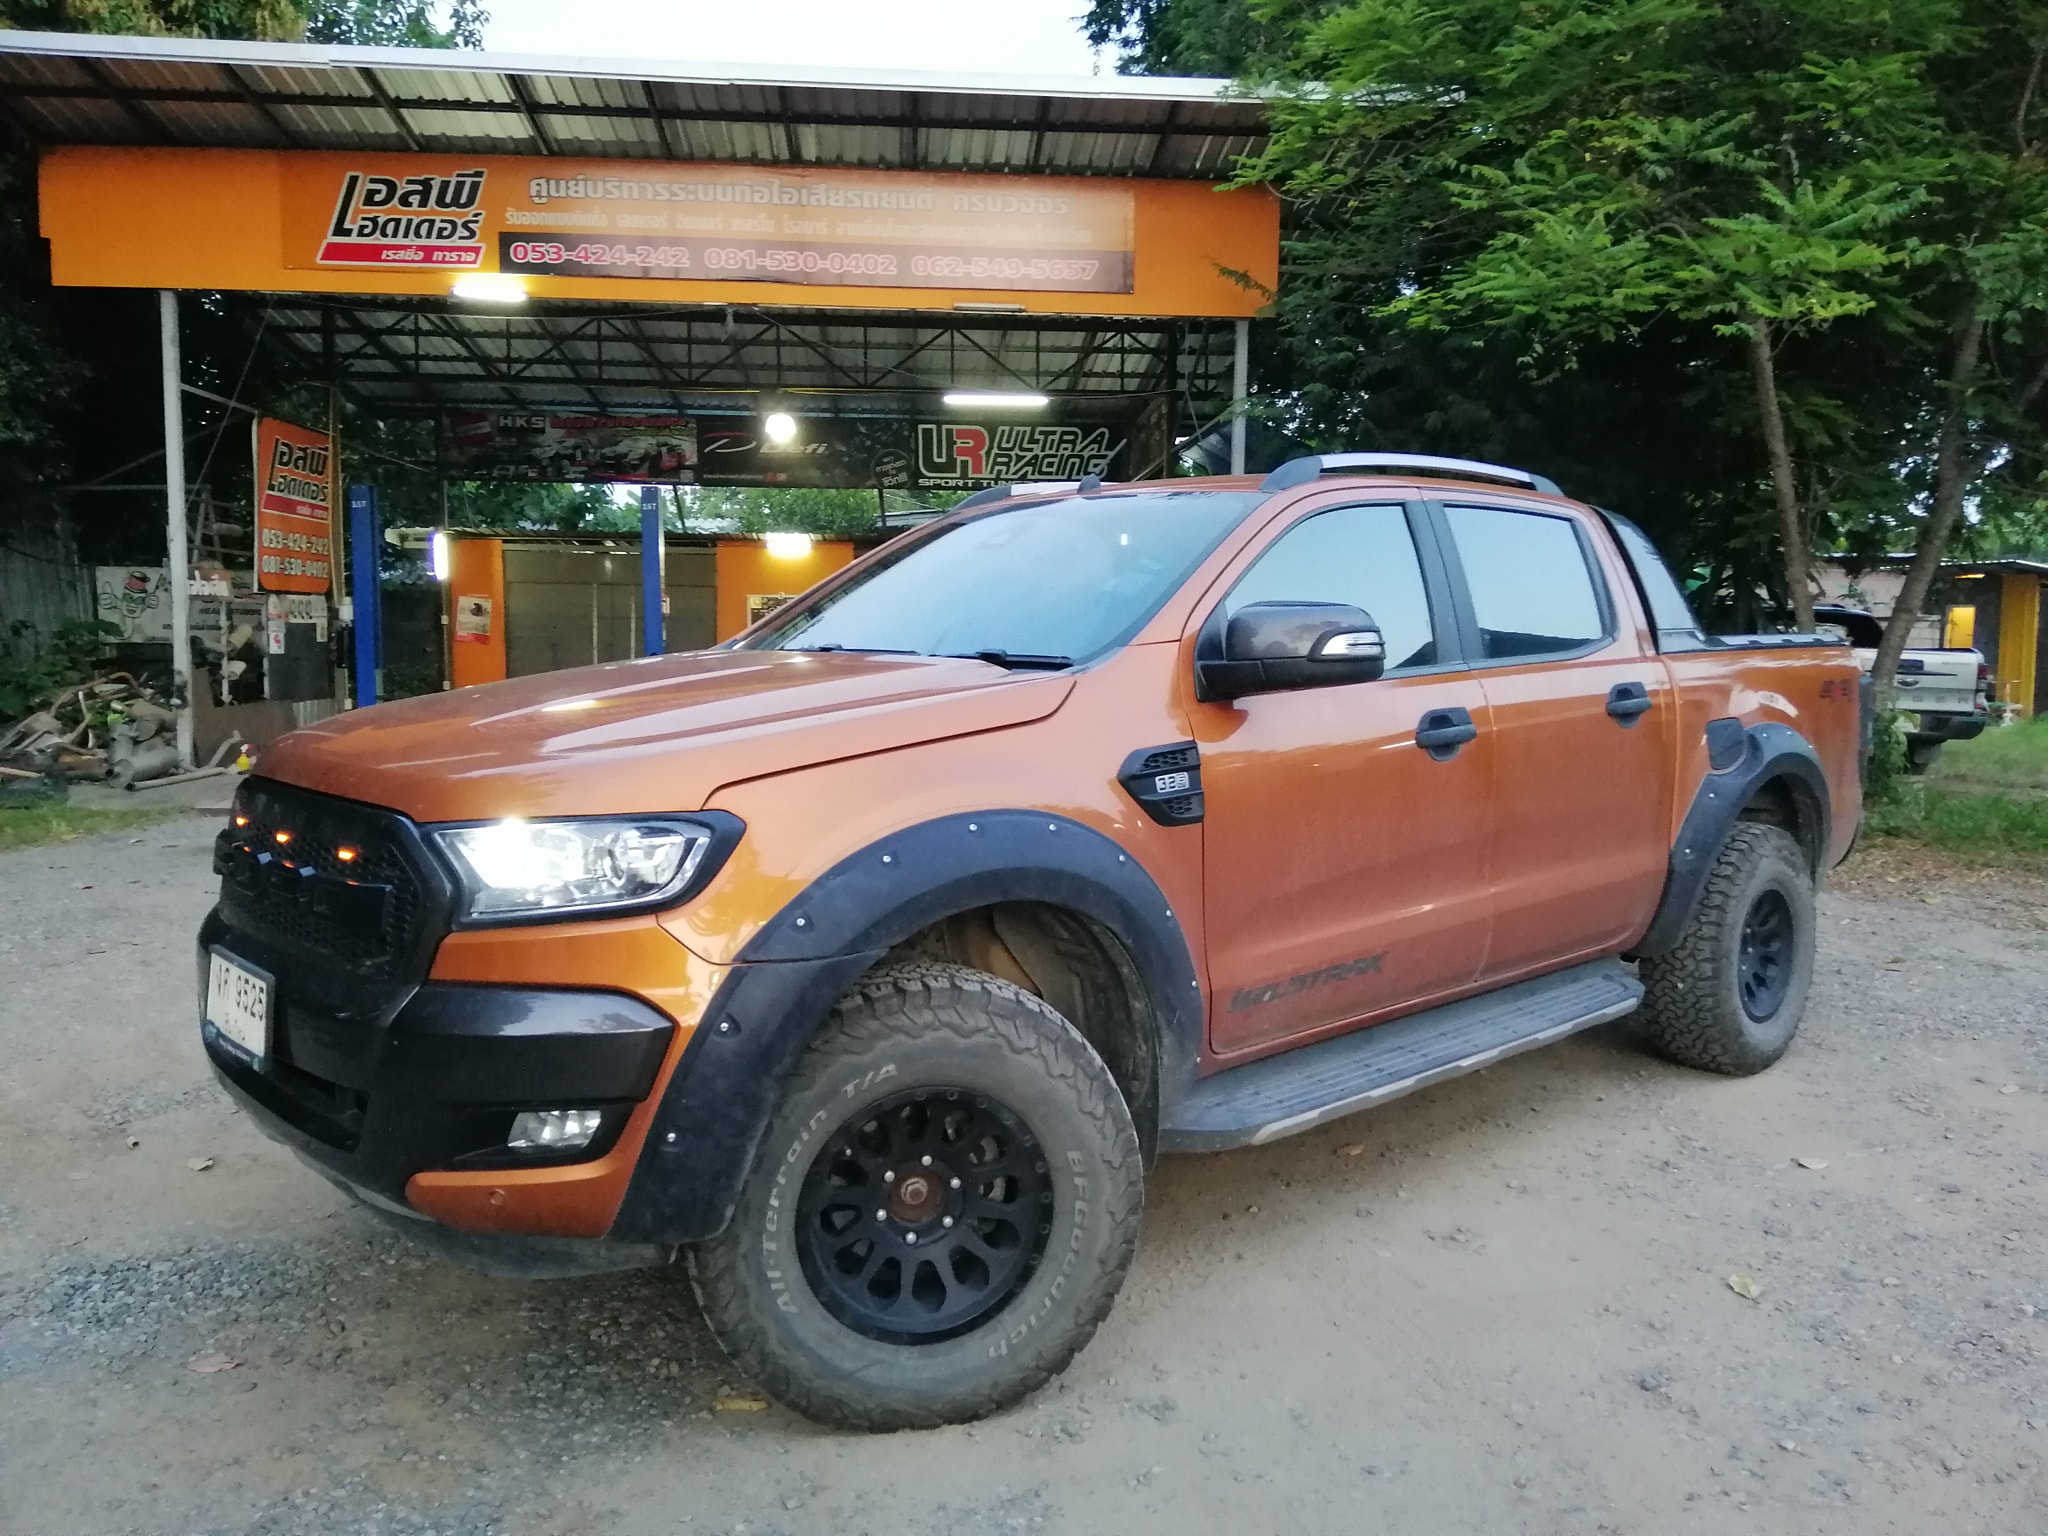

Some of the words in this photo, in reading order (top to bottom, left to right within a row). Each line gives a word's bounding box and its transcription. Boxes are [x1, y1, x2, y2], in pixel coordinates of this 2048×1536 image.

[511, 241, 690, 267] 053-424-242
[704, 247, 897, 275] 081-530-0402
[499, 415, 545, 428] HKS
[996, 426, 1110, 453] ULTRA
[988, 451, 1110, 479] RACING
[918, 479, 975, 487] SPORT
